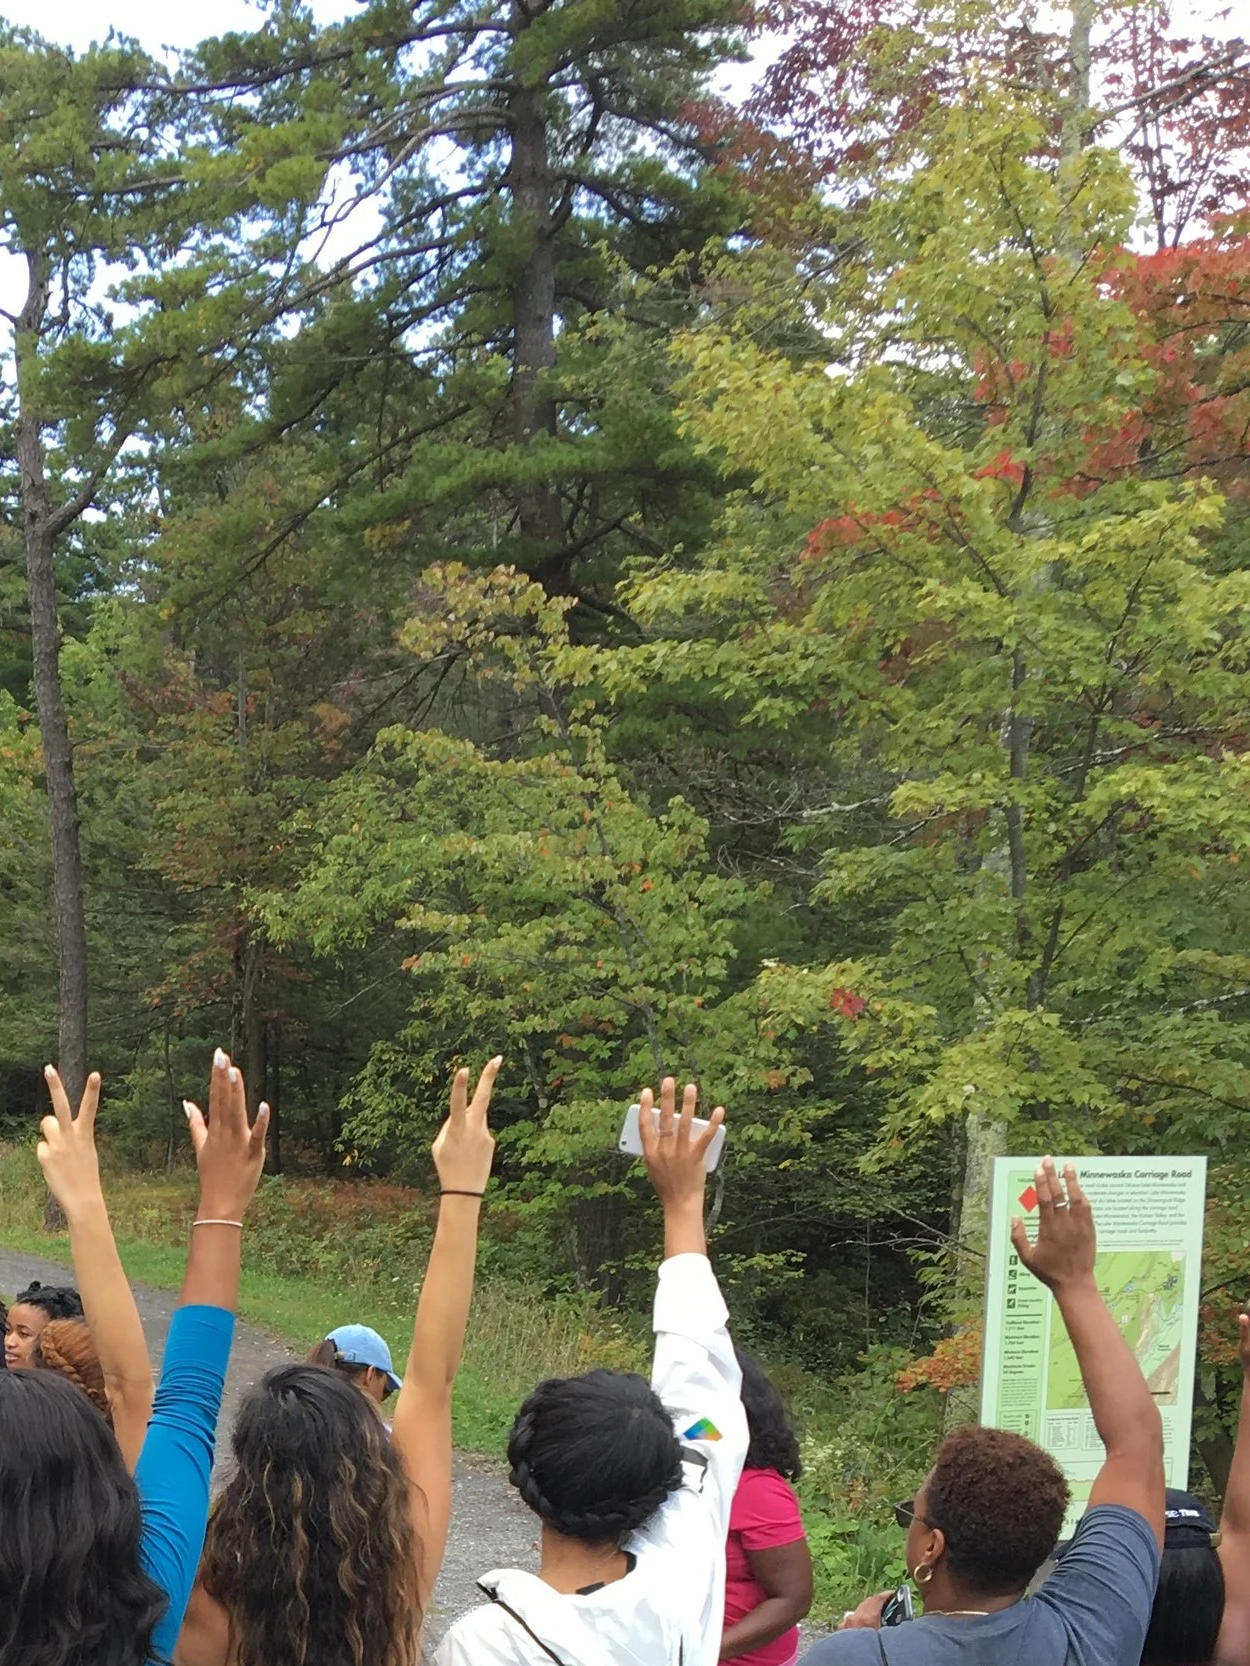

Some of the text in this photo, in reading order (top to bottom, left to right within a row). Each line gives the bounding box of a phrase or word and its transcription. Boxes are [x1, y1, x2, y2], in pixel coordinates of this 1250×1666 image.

[1079, 1170, 1193, 1180] Minnewaska Carriage Road
